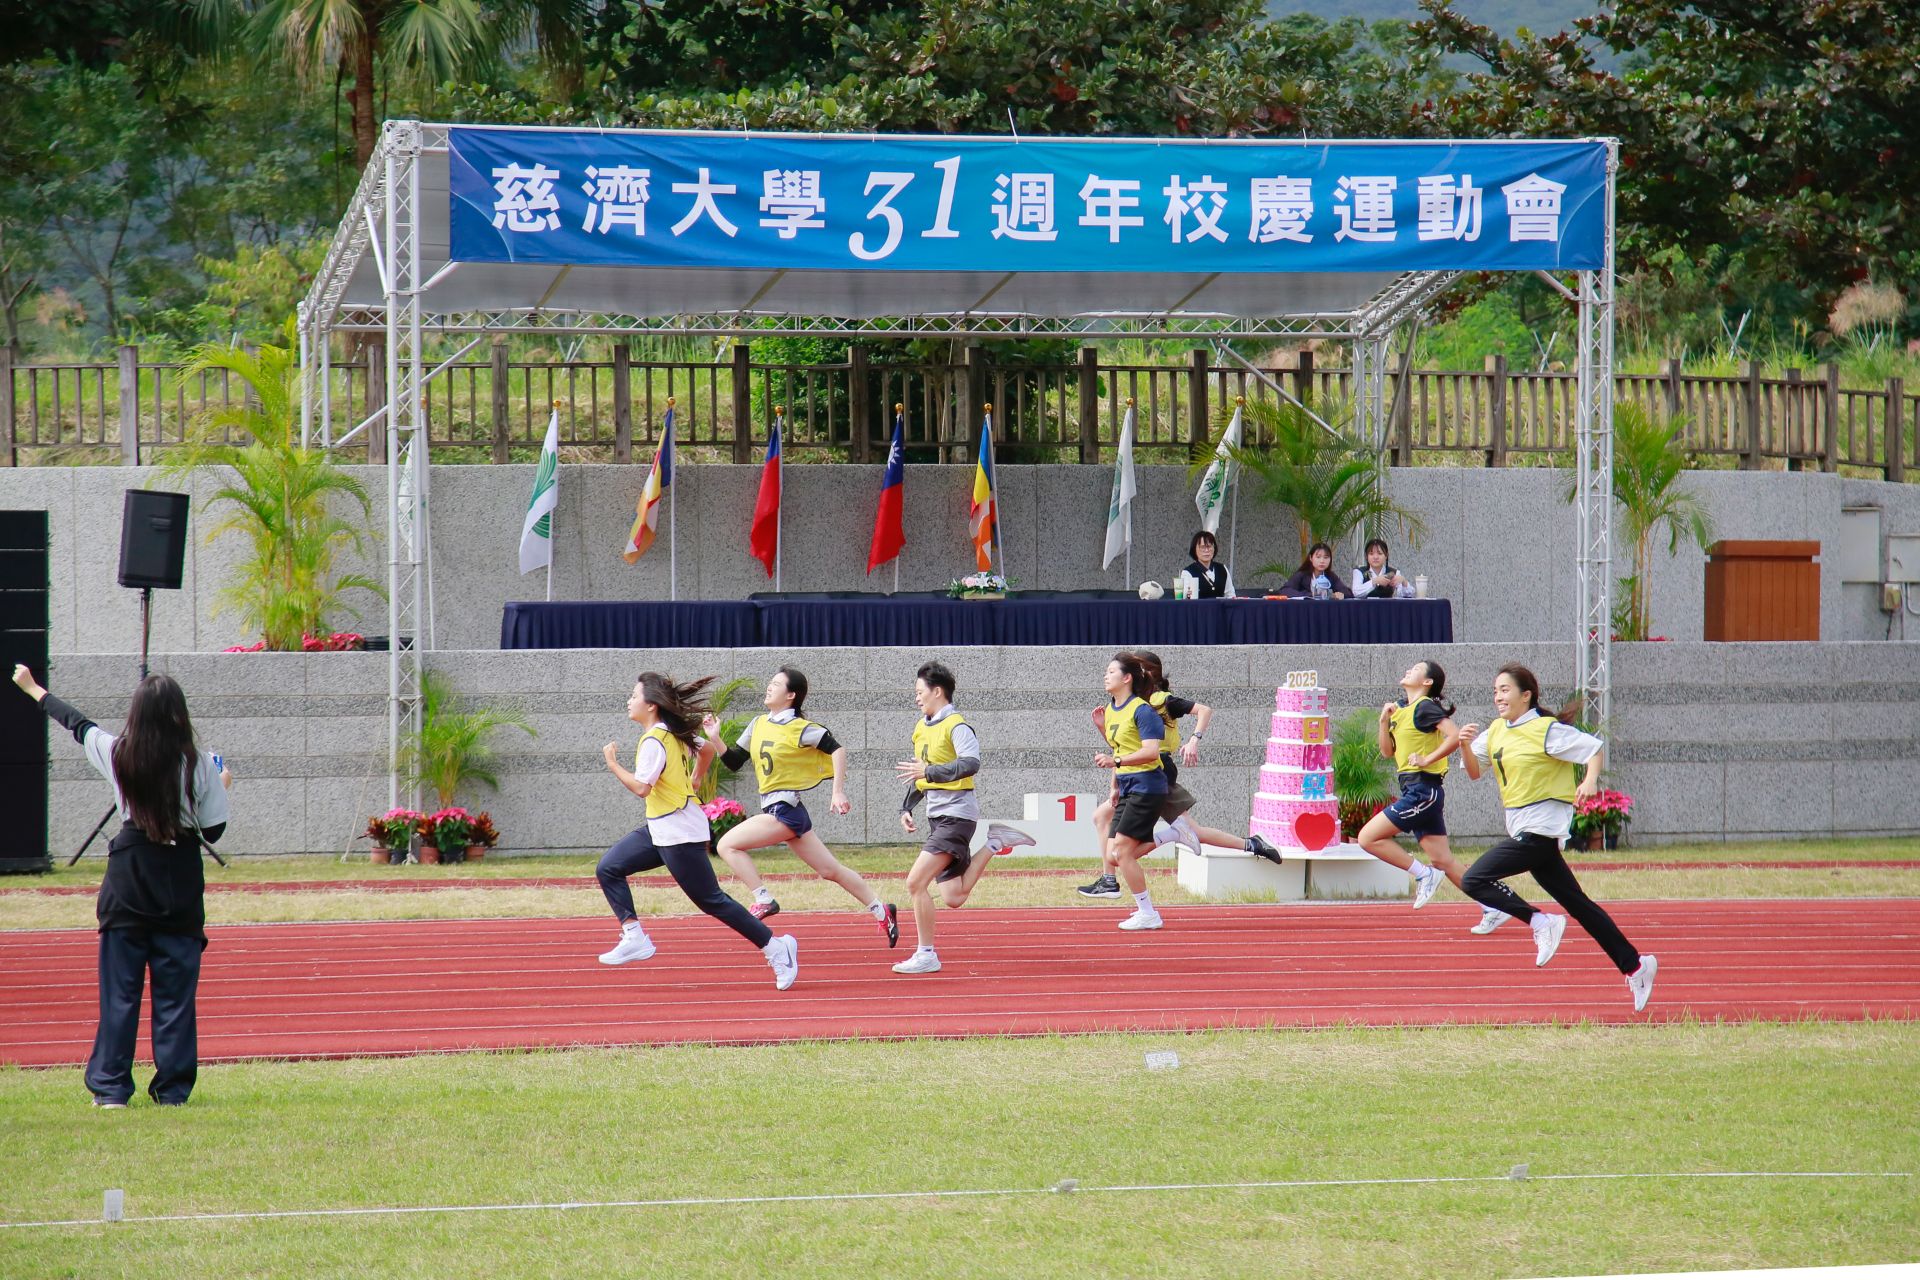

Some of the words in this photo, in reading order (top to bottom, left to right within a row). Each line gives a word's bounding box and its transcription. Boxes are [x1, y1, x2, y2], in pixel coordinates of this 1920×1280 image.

[1288, 672, 1317, 688] 2025
[760, 740, 775, 776] 5
[1492, 746, 1508, 787] 1
[1057, 795, 1076, 821] 1
